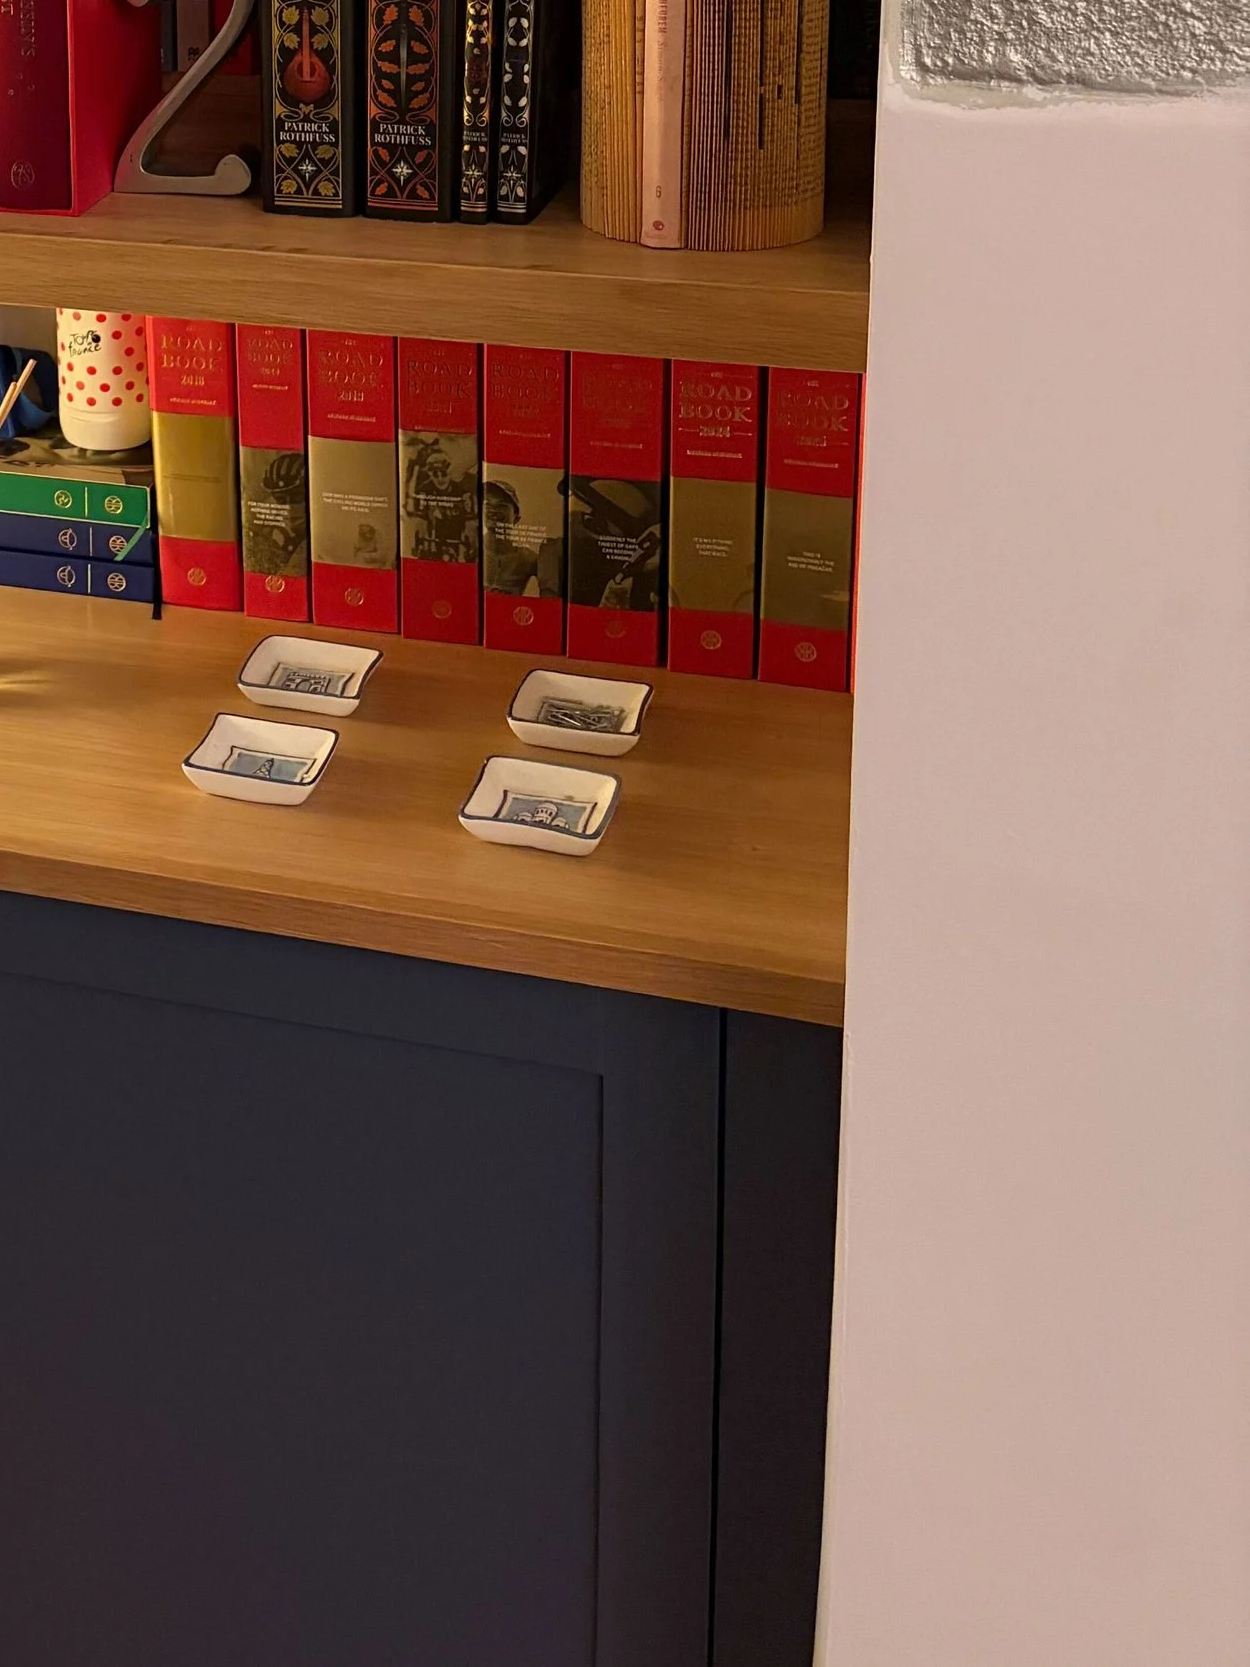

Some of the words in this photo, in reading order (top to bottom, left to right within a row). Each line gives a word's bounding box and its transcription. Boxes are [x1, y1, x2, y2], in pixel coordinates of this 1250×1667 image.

[284, 122, 330, 133] PATRICK
[280, 132, 335, 143] ROTHFUSS
[161, 334, 224, 351] ROAD
[161, 354, 223, 370] BOOK
[680, 381, 751, 401] ROAD
[679, 403, 751, 422] BOOK
